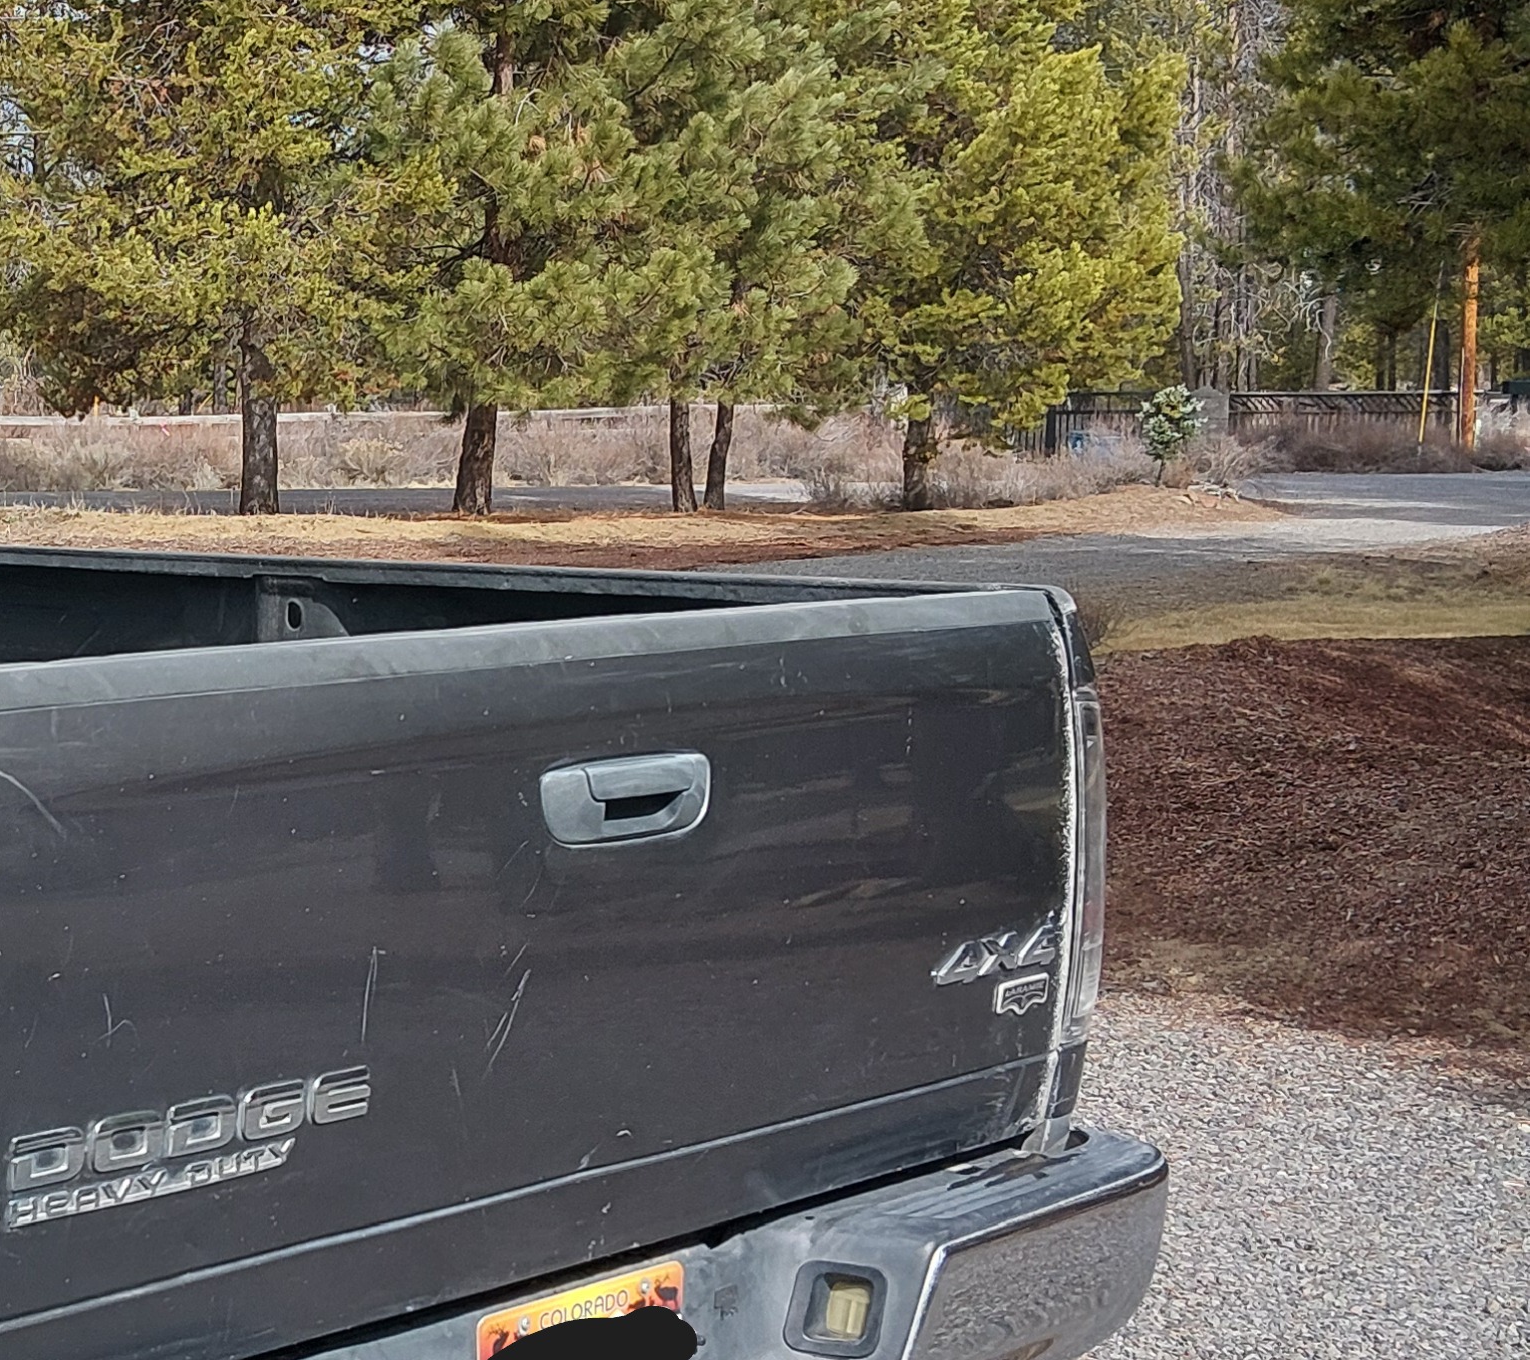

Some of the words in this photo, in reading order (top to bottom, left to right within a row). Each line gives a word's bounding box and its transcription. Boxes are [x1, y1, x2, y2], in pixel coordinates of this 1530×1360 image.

[7, 1064, 371, 1192] DODGE
[7, 1165, 168, 1228] HEAVY
[184, 1138, 296, 1186] DUTY
[540, 1289, 629, 1330] COLORADO
